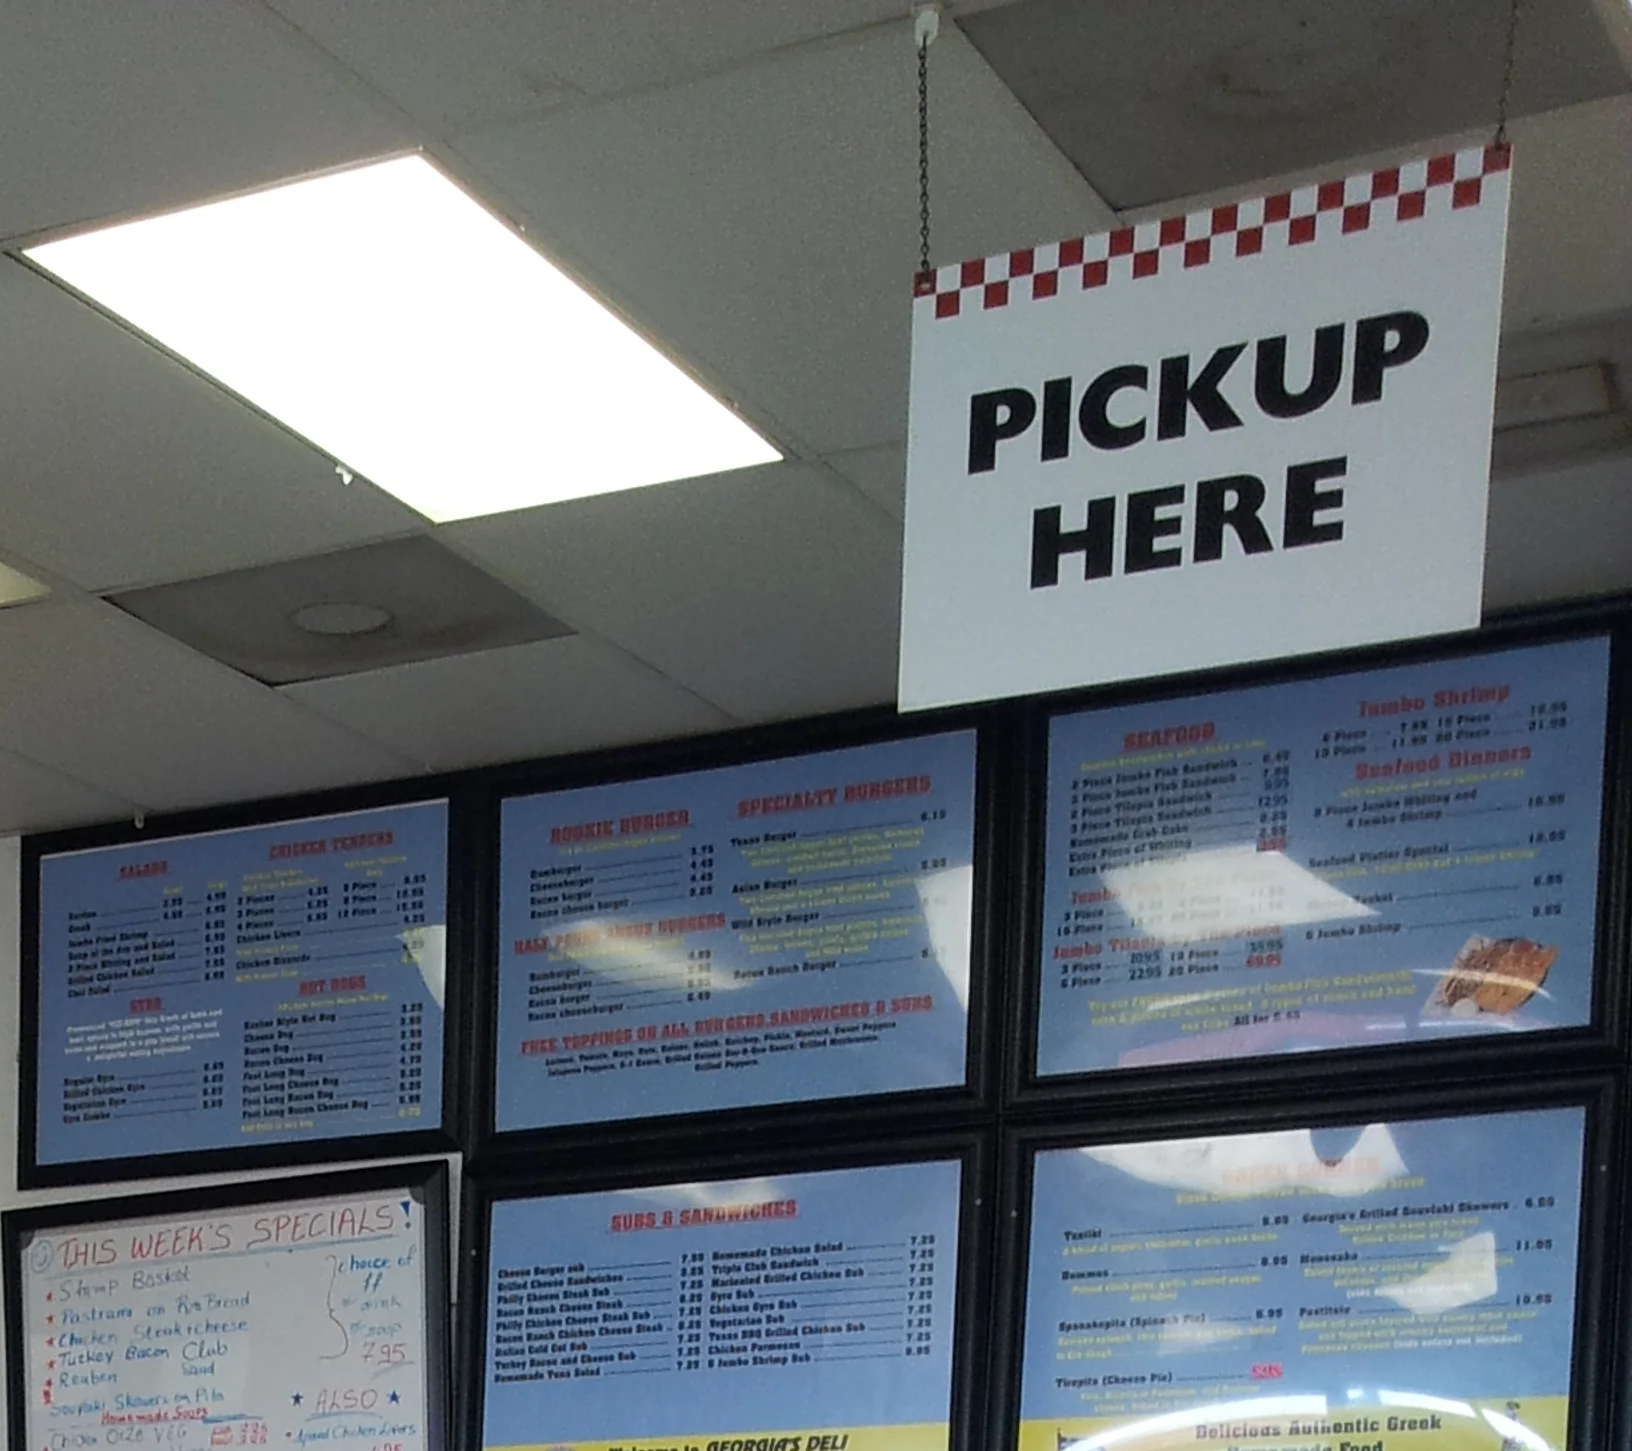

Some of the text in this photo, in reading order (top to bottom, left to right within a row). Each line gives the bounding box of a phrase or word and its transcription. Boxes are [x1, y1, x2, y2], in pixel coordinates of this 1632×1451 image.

[968, 309, 1430, 475] PICKUP
[1030, 456, 1348, 590] HERE
[1358, 685, 1510, 718] Jumbo Shrimp
[1123, 722, 1215, 750] SEAFOOD
[1355, 745, 1532, 782] Seafood Dinners
[737, 775, 932, 819] SPECIALTY BURGERS
[619, 808, 690, 836] BURGER
[562, 1028, 633, 1051] TOPPINGS
[661, 1021, 689, 1038] ALL
[611, 1199, 798, 1234] SUBS SANDWICHES
[57, 1237, 117, 1269] THIS
[131, 1223, 232, 1259] WEEK'S
[770, 1245, 811, 1257] Chicken
[770, 1258, 819, 1270] Sandwich
[59, 1350, 114, 1367] Turkey
[182, 1340, 229, 1361] Club
[59, 1372, 118, 1388] Reuben
[315, 1388, 379, 1412] ALSO
[1195, 1414, 1442, 1440] Delicious Authentic Greek
[806, 1434, 849, 1451] DELI
